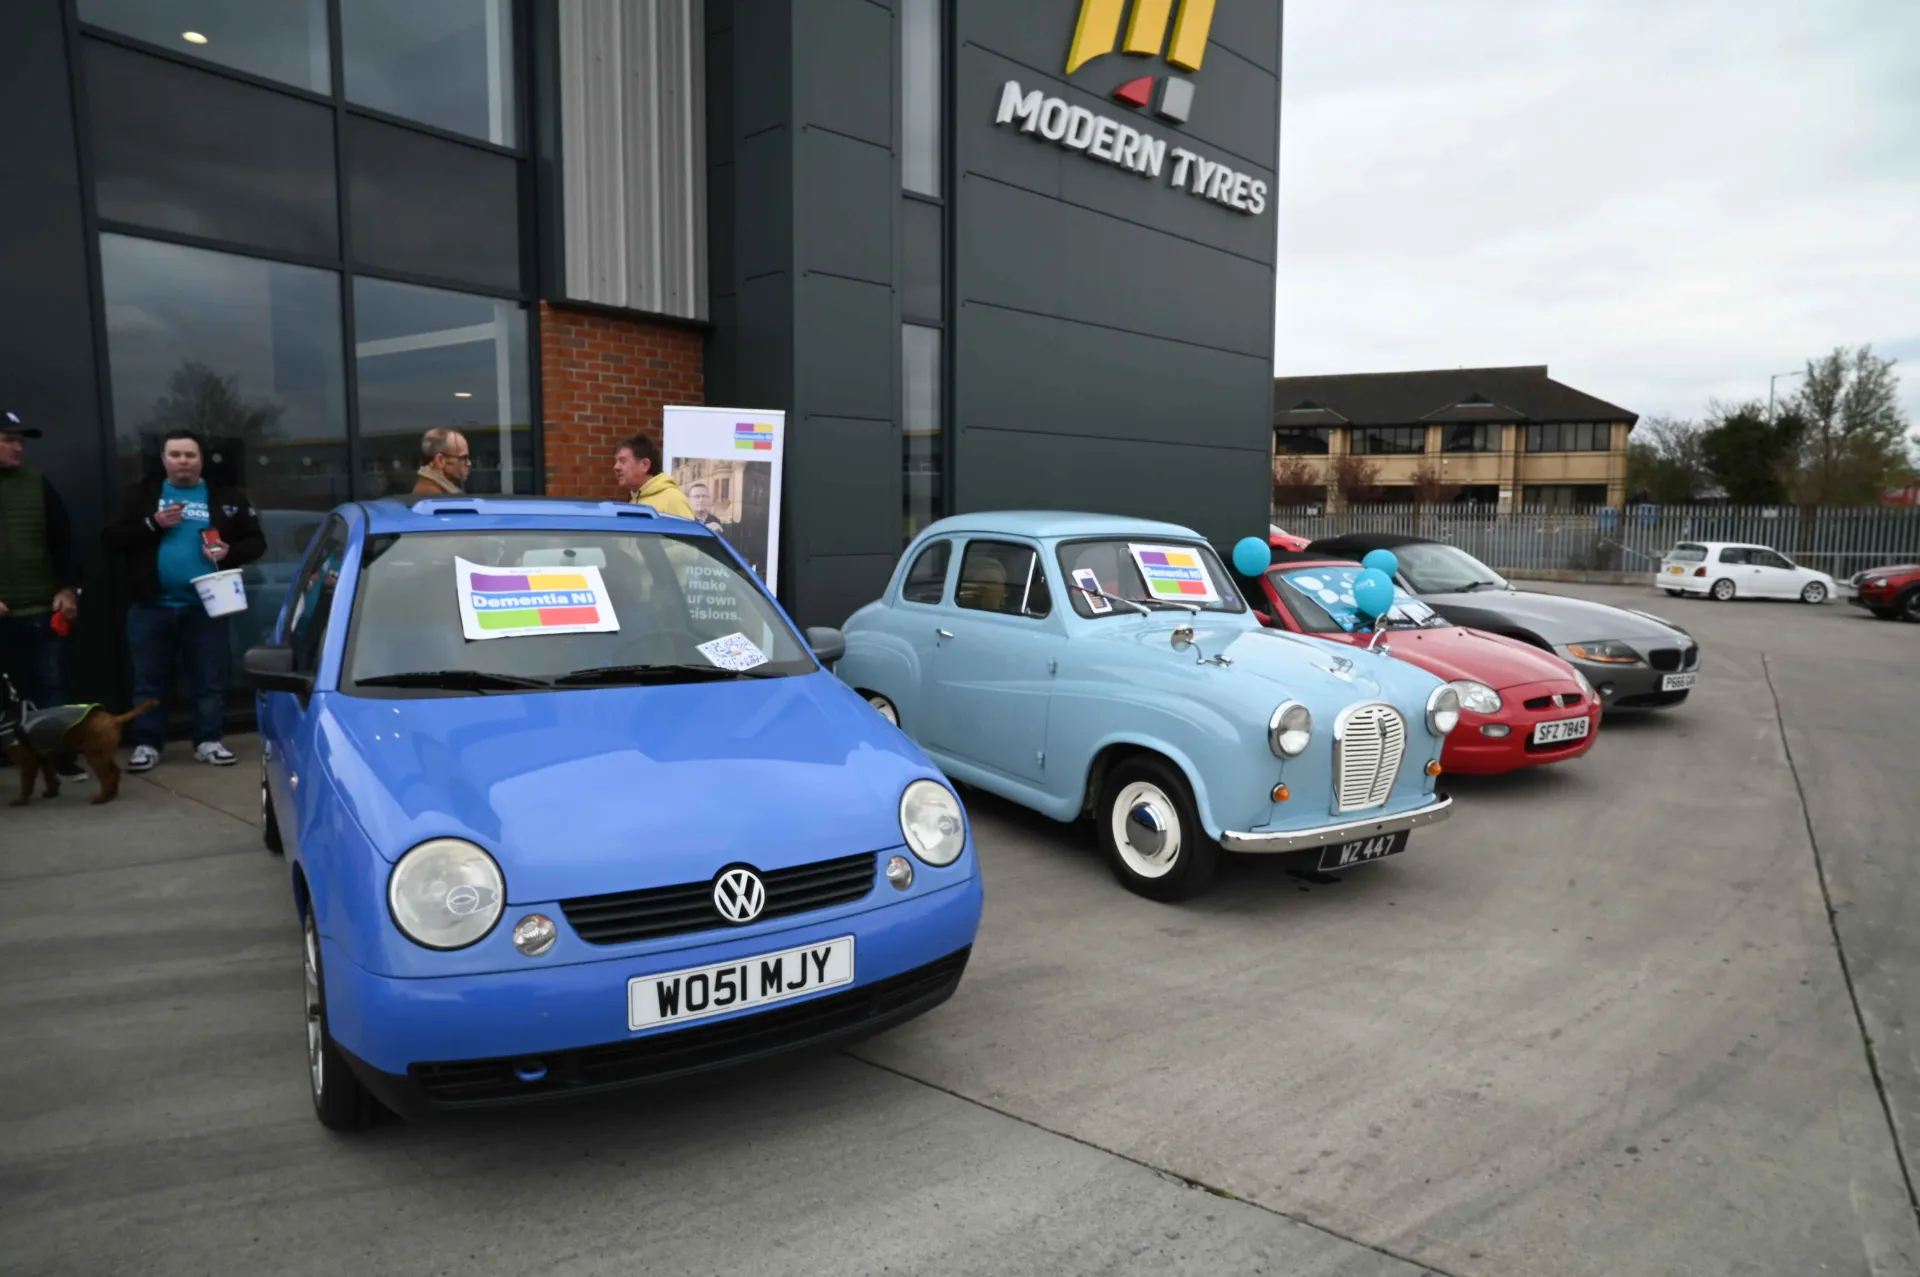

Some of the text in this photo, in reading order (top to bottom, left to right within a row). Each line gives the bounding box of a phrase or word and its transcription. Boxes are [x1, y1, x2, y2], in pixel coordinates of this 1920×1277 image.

[996, 80, 1268, 215] MODERN TYRES
[1145, 567, 1202, 579] Dementia NI
[689, 580, 726, 591] make
[473, 592, 594, 608] Dementia NI
[706, 596, 736, 605] own
[1539, 720, 1586, 740] SFZ 7849
[1363, 834, 1396, 858] 447
[656, 947, 832, 1018] WO51 MJY
